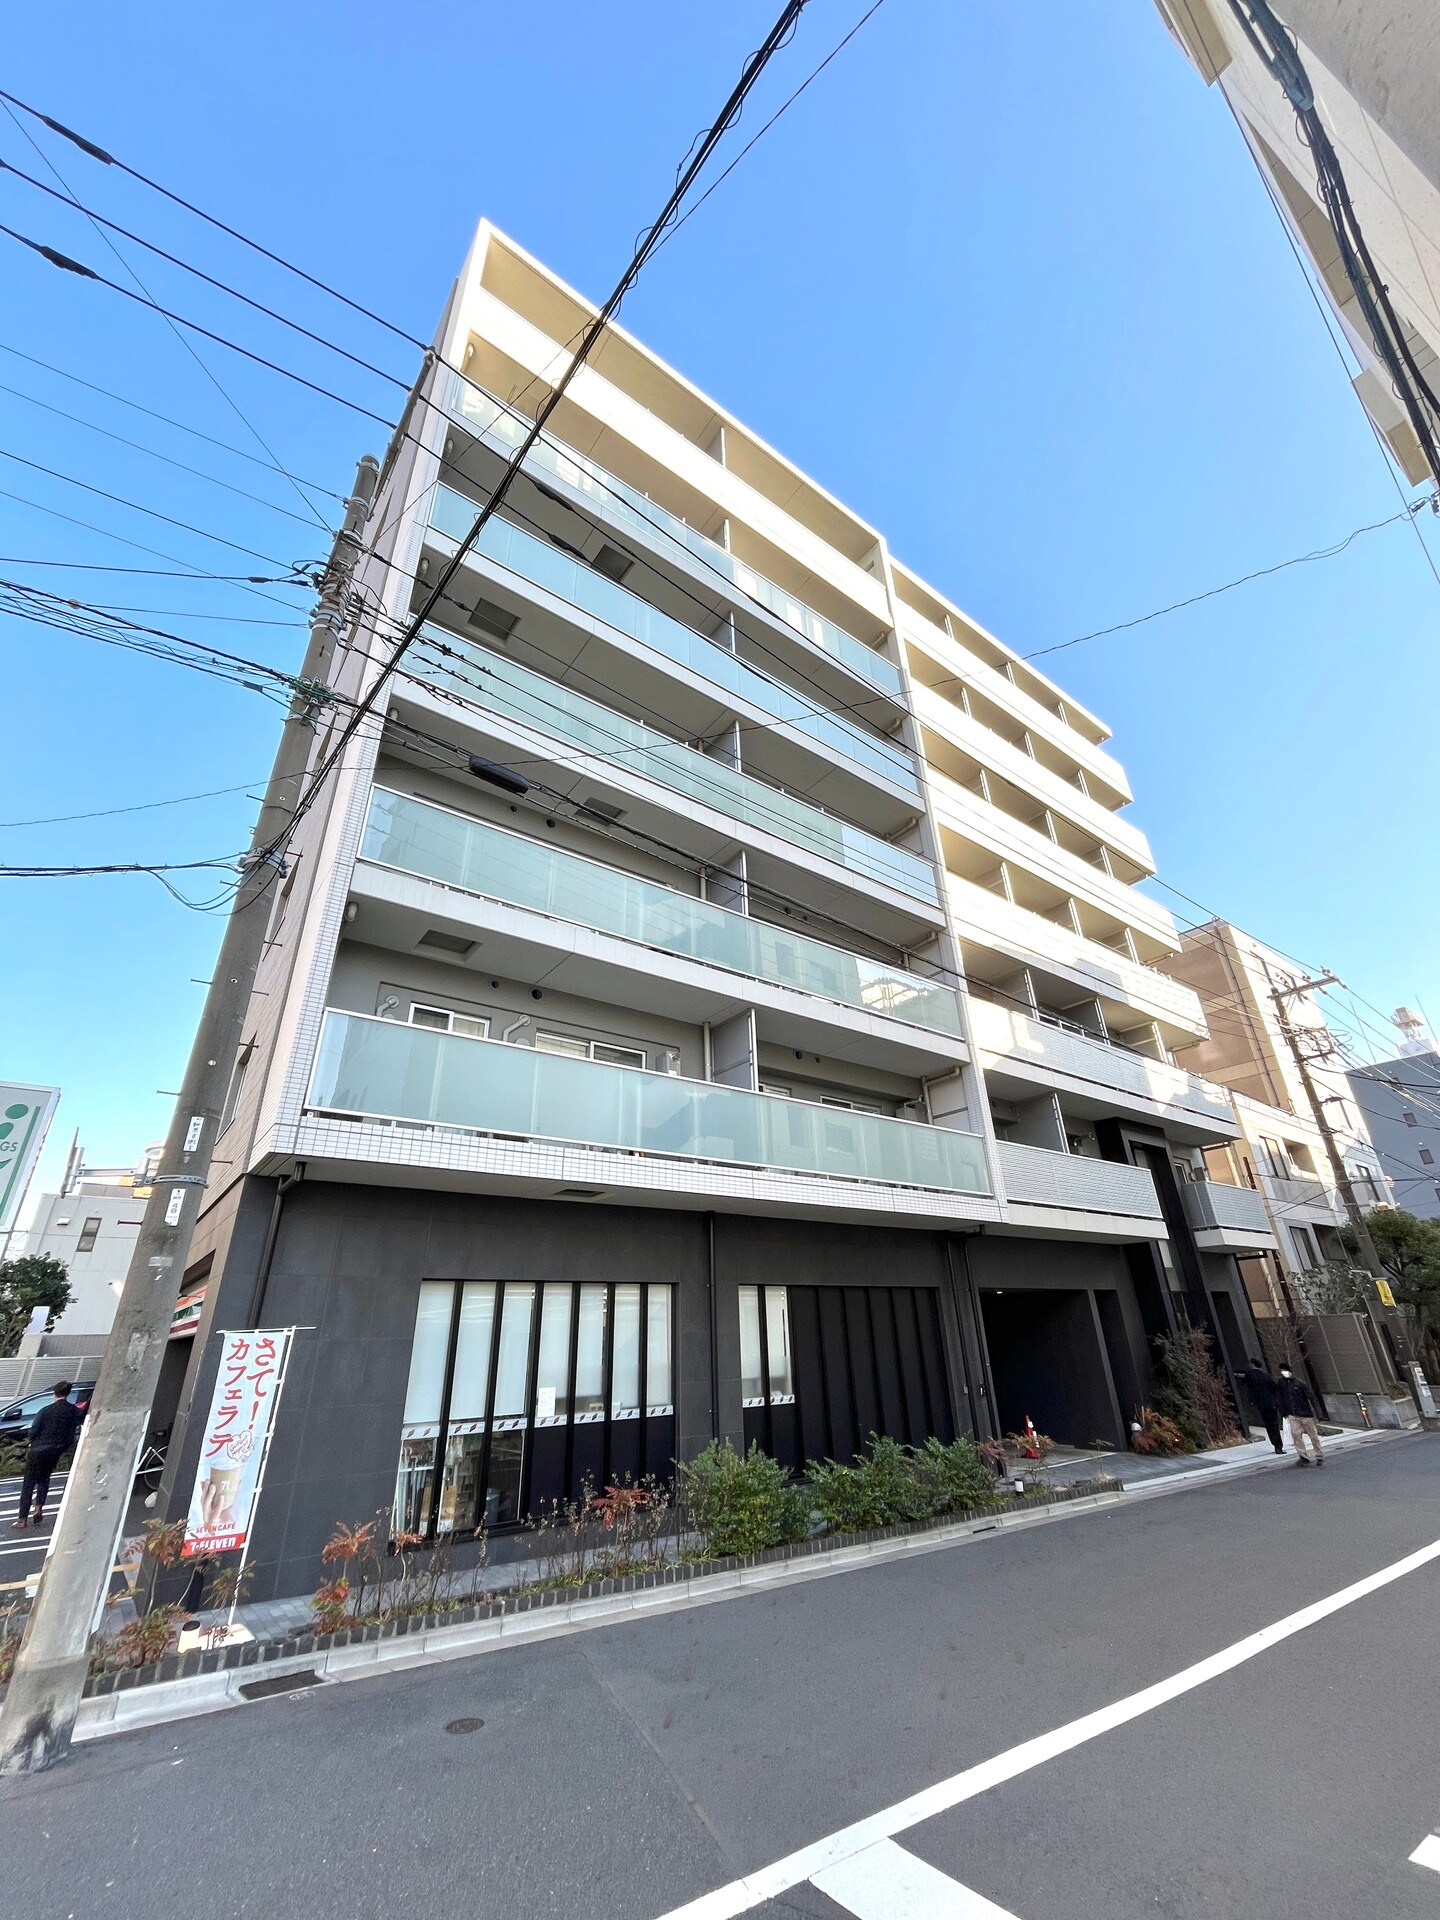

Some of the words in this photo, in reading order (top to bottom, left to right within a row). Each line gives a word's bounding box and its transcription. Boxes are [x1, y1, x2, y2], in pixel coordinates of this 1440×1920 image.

[205, 1338, 250, 1457] カフェラテ
